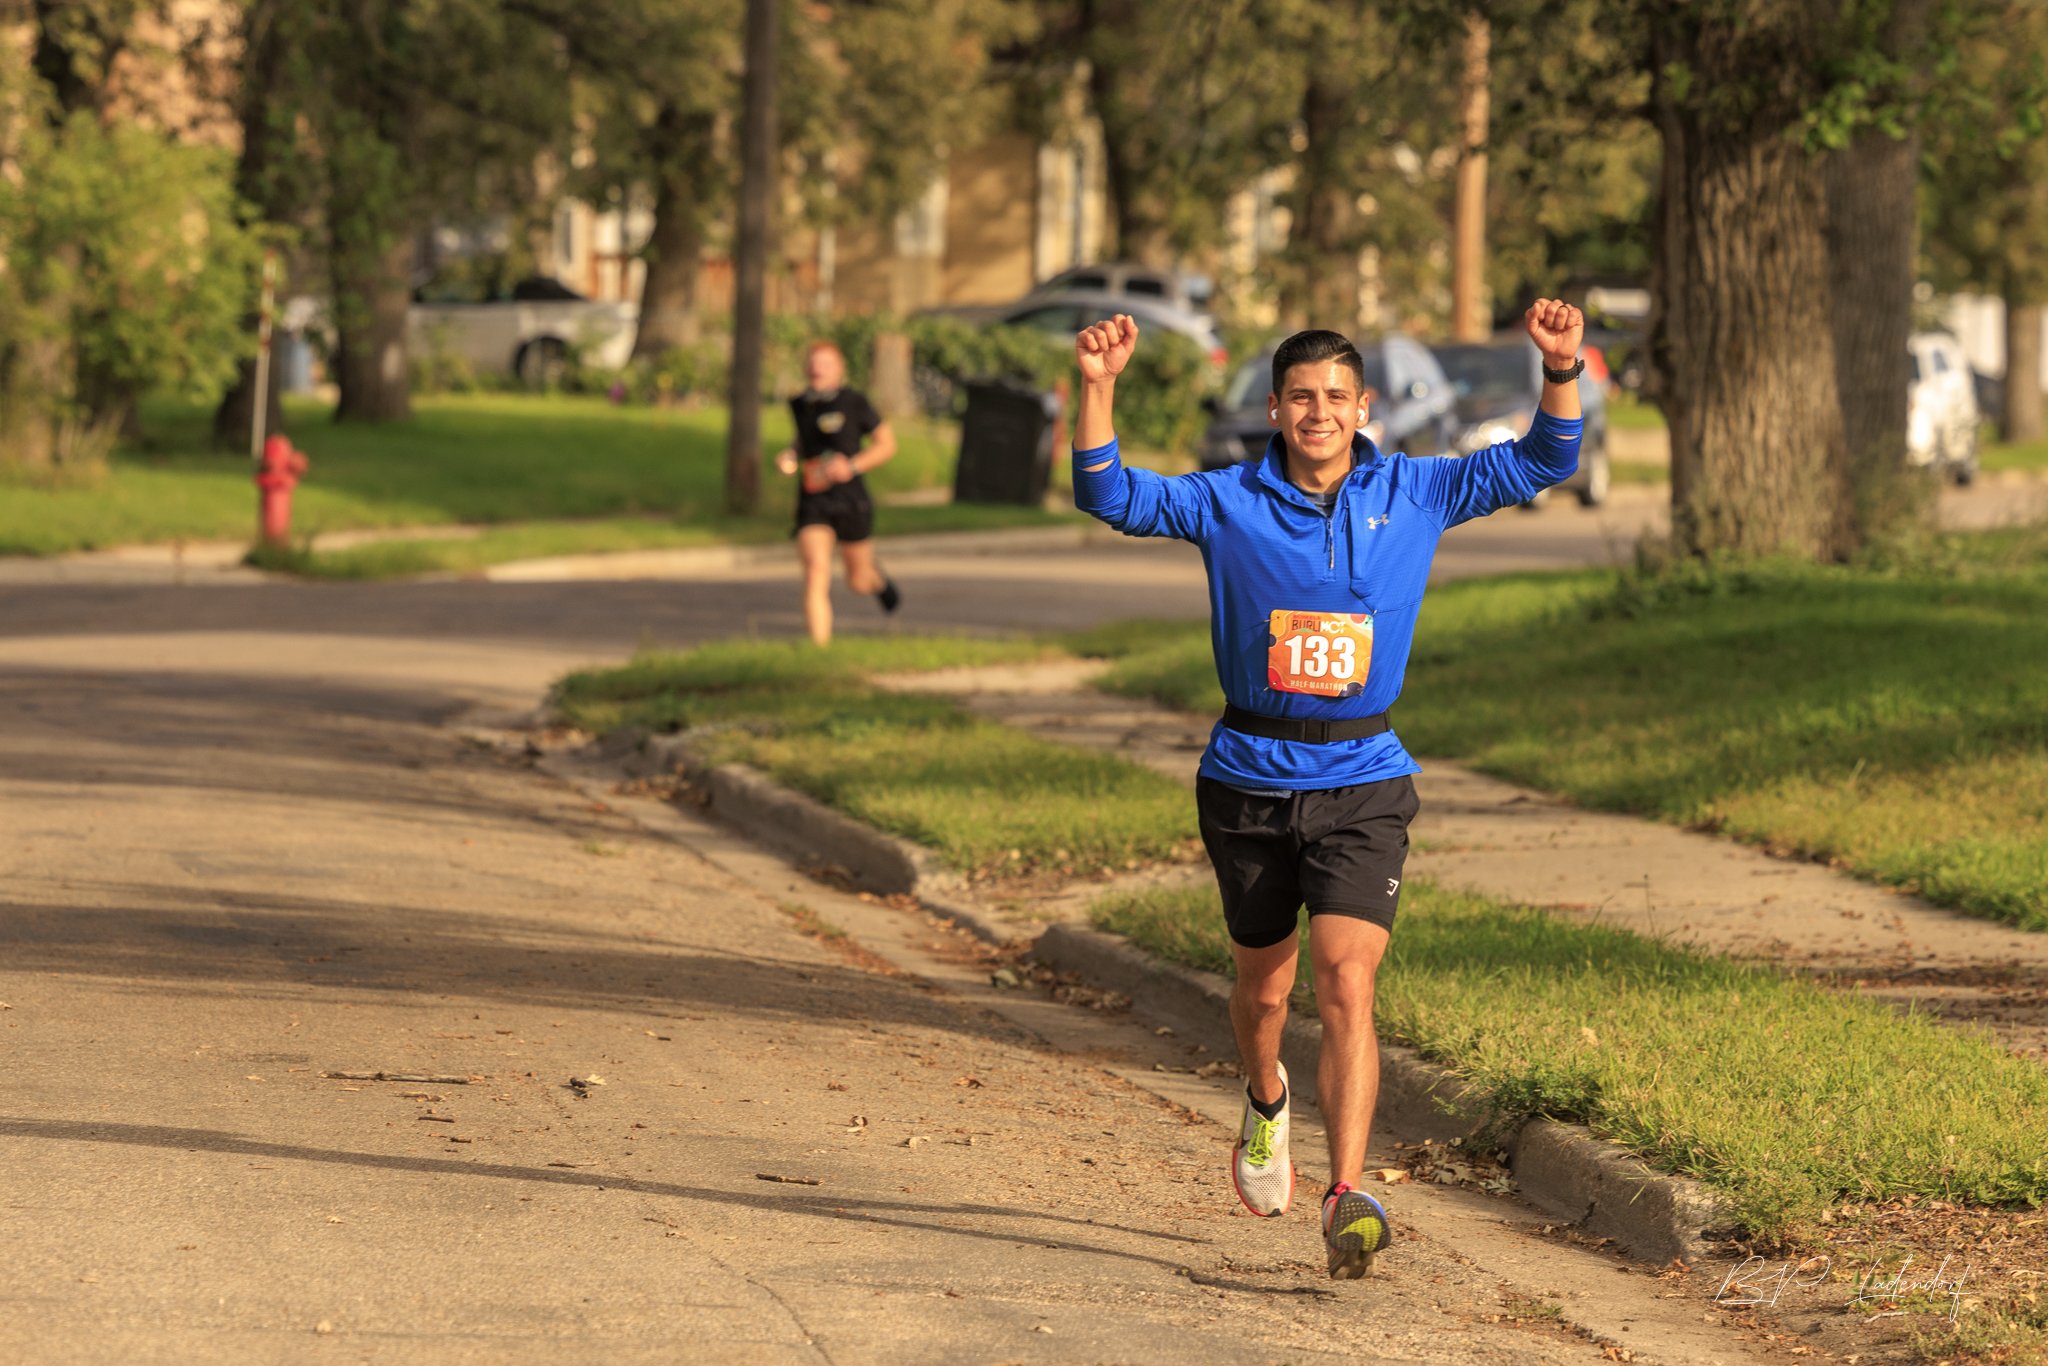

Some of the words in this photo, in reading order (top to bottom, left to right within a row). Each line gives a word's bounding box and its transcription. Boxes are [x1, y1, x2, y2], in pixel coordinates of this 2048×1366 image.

[1284, 634, 1356, 679] 133
[1290, 680, 1309, 689] HALF
[1310, 681, 1348, 691] MARATHON
